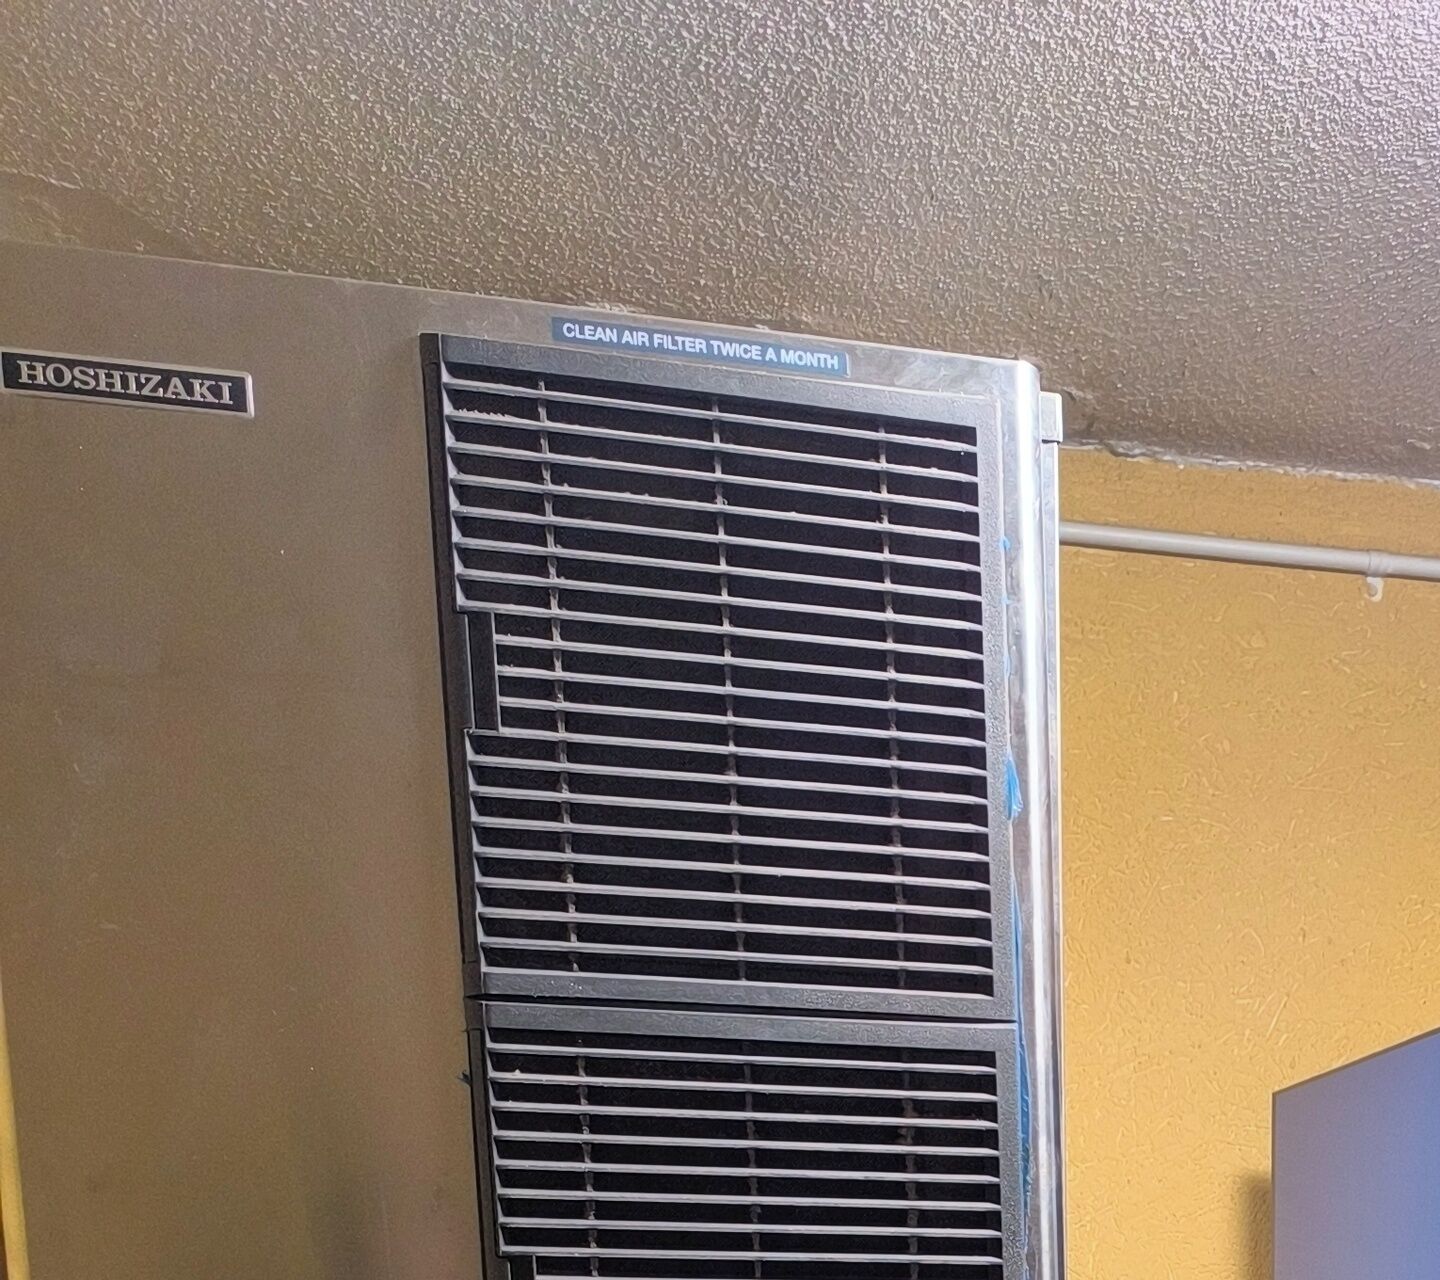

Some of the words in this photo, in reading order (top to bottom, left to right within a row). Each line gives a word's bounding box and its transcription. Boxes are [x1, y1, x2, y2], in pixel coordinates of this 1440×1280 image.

[563, 322, 617, 344] CLEAN
[621, 329, 650, 348] AIR
[653, 333, 707, 354] FILTER
[709, 339, 762, 362] TWICE
[765, 347, 777, 362] A
[780, 348, 839, 370] MONTH
[16, 359, 234, 405] HOSHIZAKI
